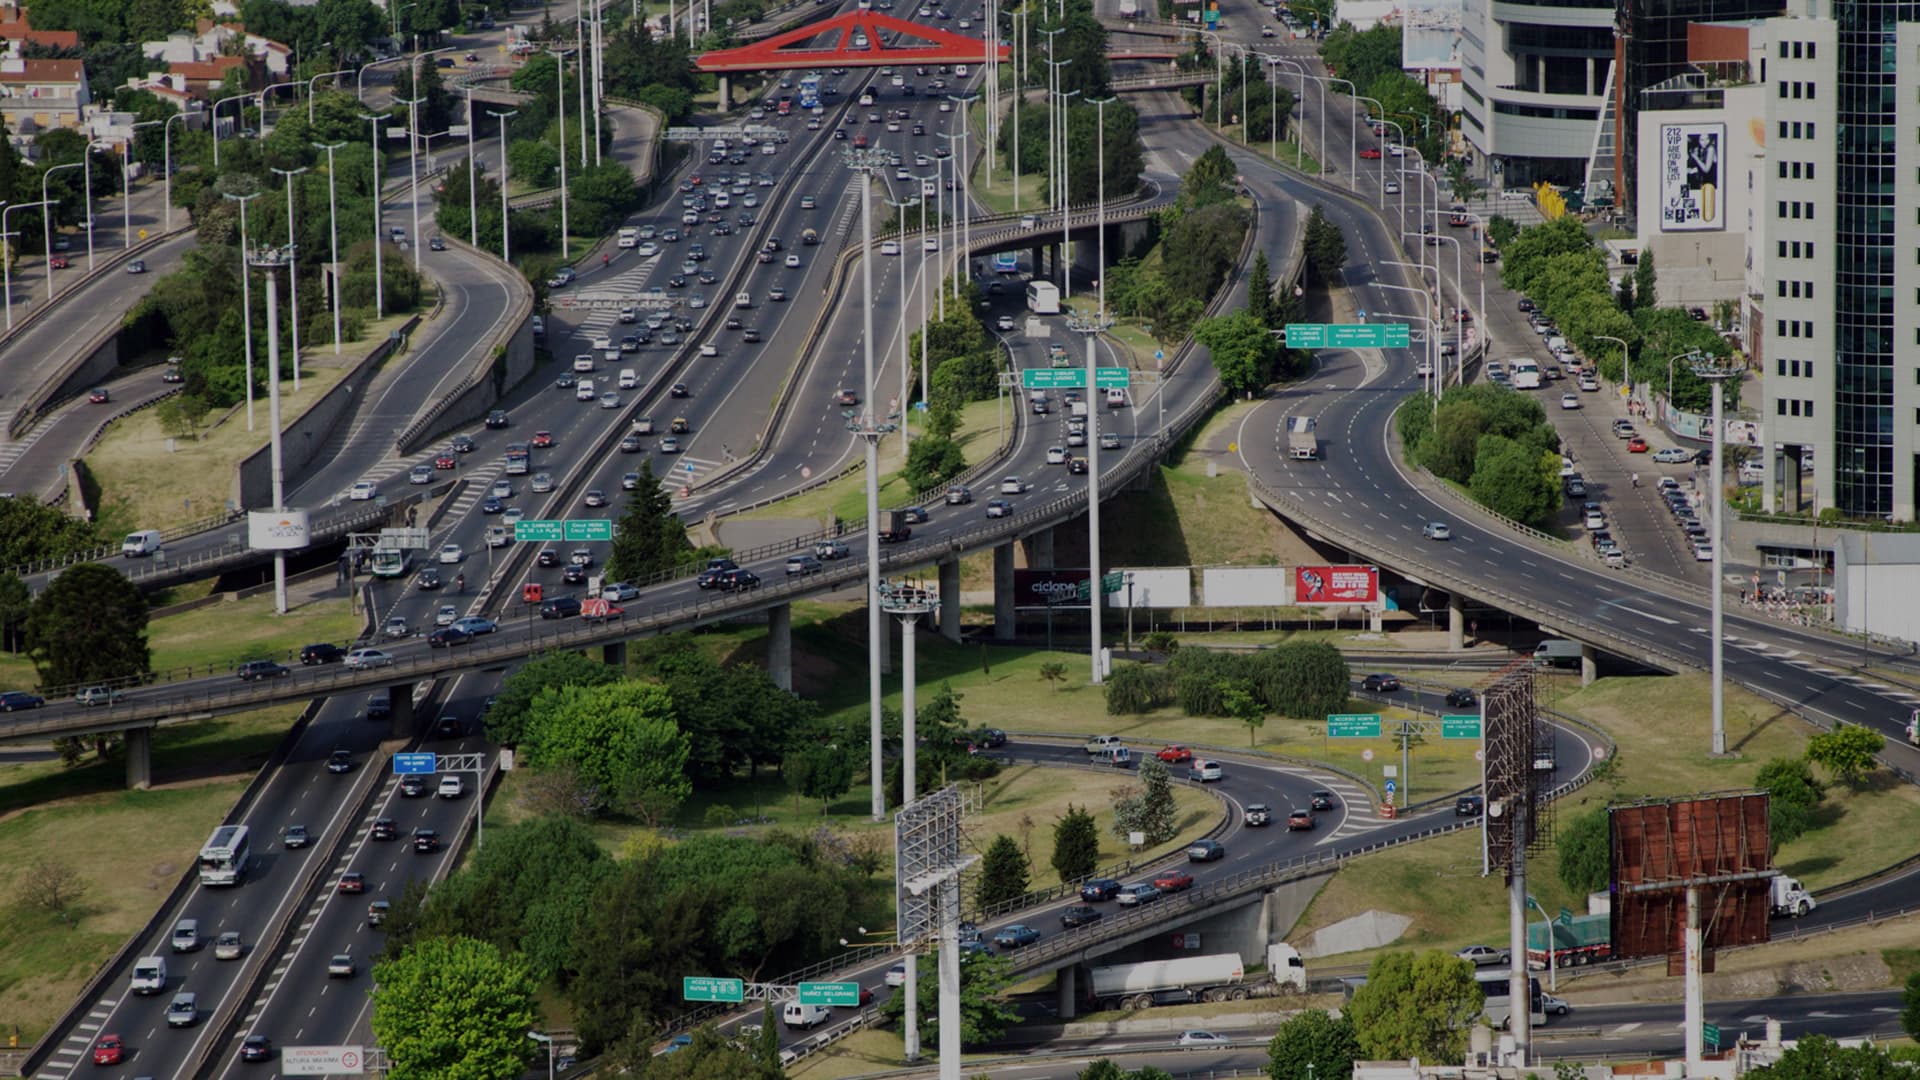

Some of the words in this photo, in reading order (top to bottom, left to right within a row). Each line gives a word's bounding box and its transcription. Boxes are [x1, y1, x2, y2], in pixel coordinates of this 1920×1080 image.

[1667, 128, 1681, 136] 212
[1667, 137, 1681, 145] VIP
[1668, 145, 1680, 153] ARE
